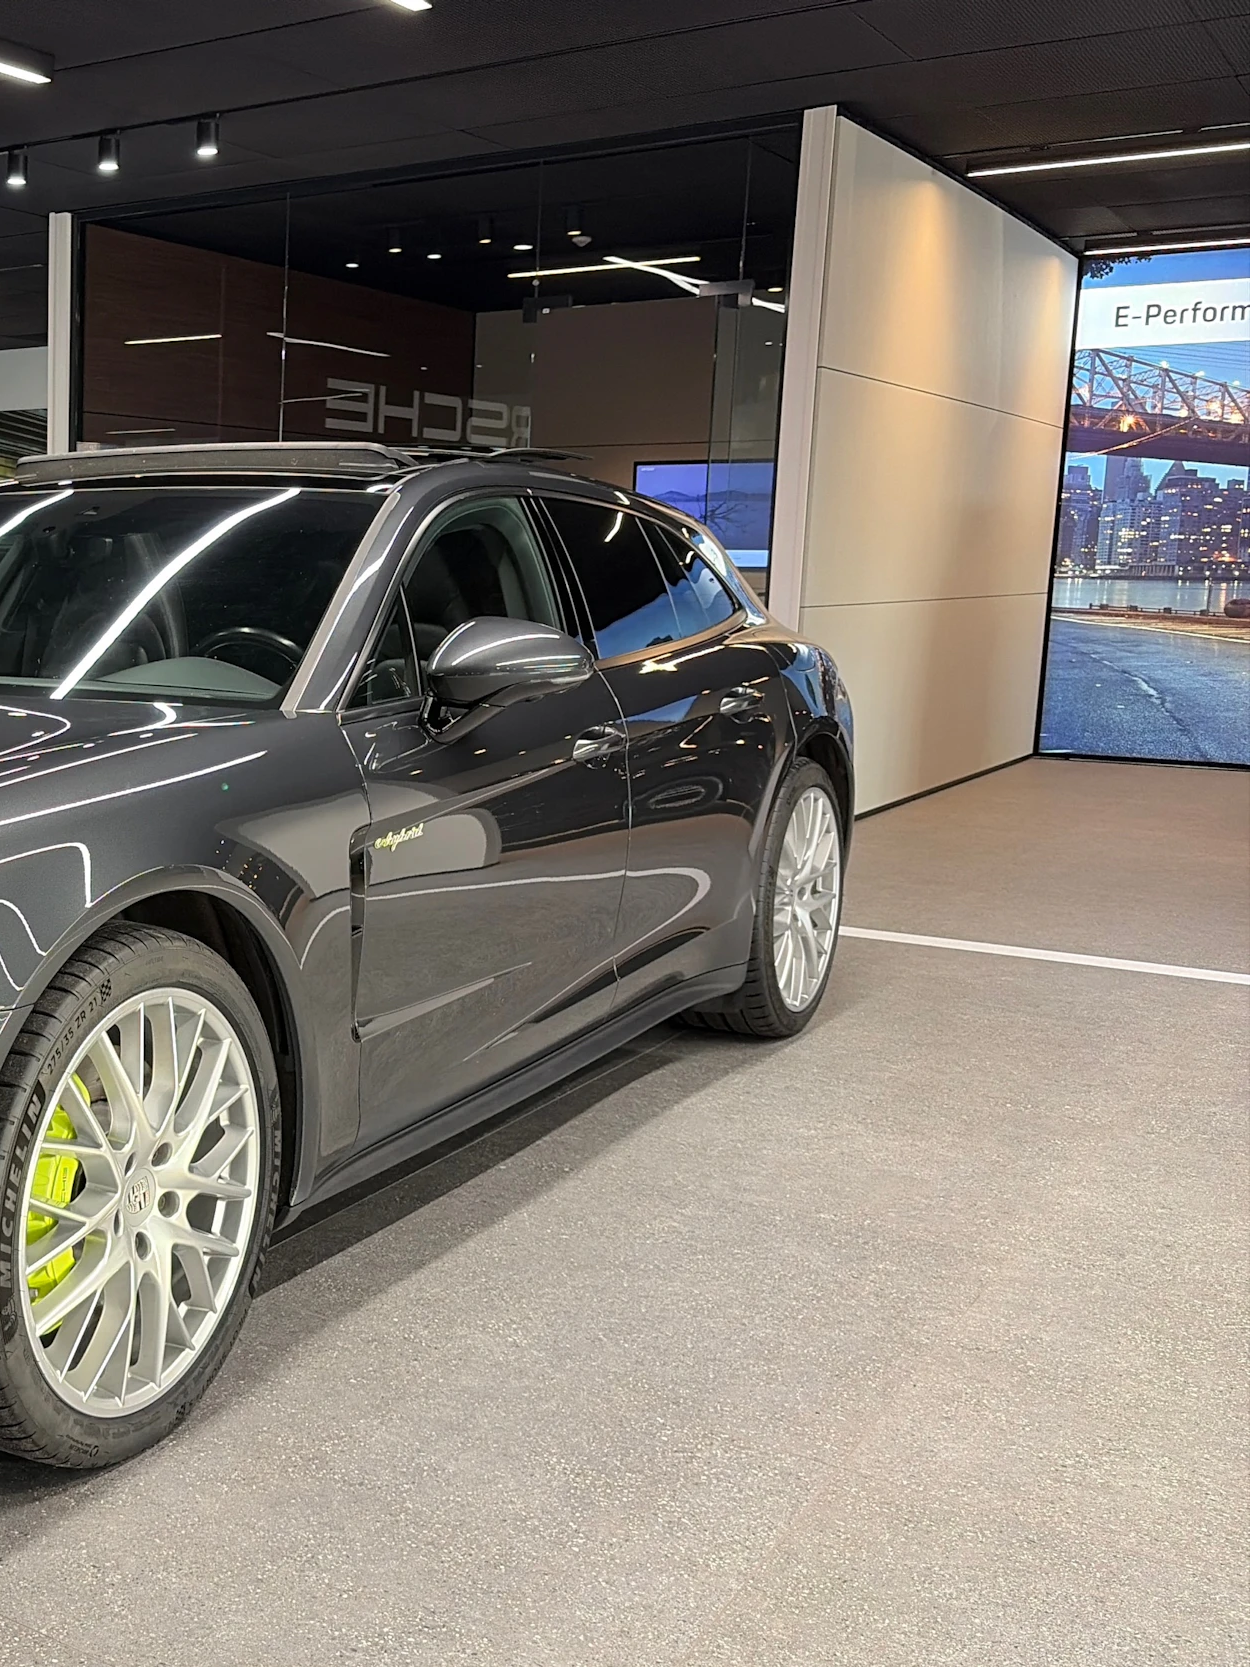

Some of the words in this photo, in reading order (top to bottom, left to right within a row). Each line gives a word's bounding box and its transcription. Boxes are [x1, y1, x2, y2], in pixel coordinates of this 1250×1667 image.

[1115, 301, 1250, 328] E-Perform
[47, 1029, 74, 1075] 275/35
[75, 1010, 86, 1029] ZR
[0, 1094, 42, 1288] MICHELIN
